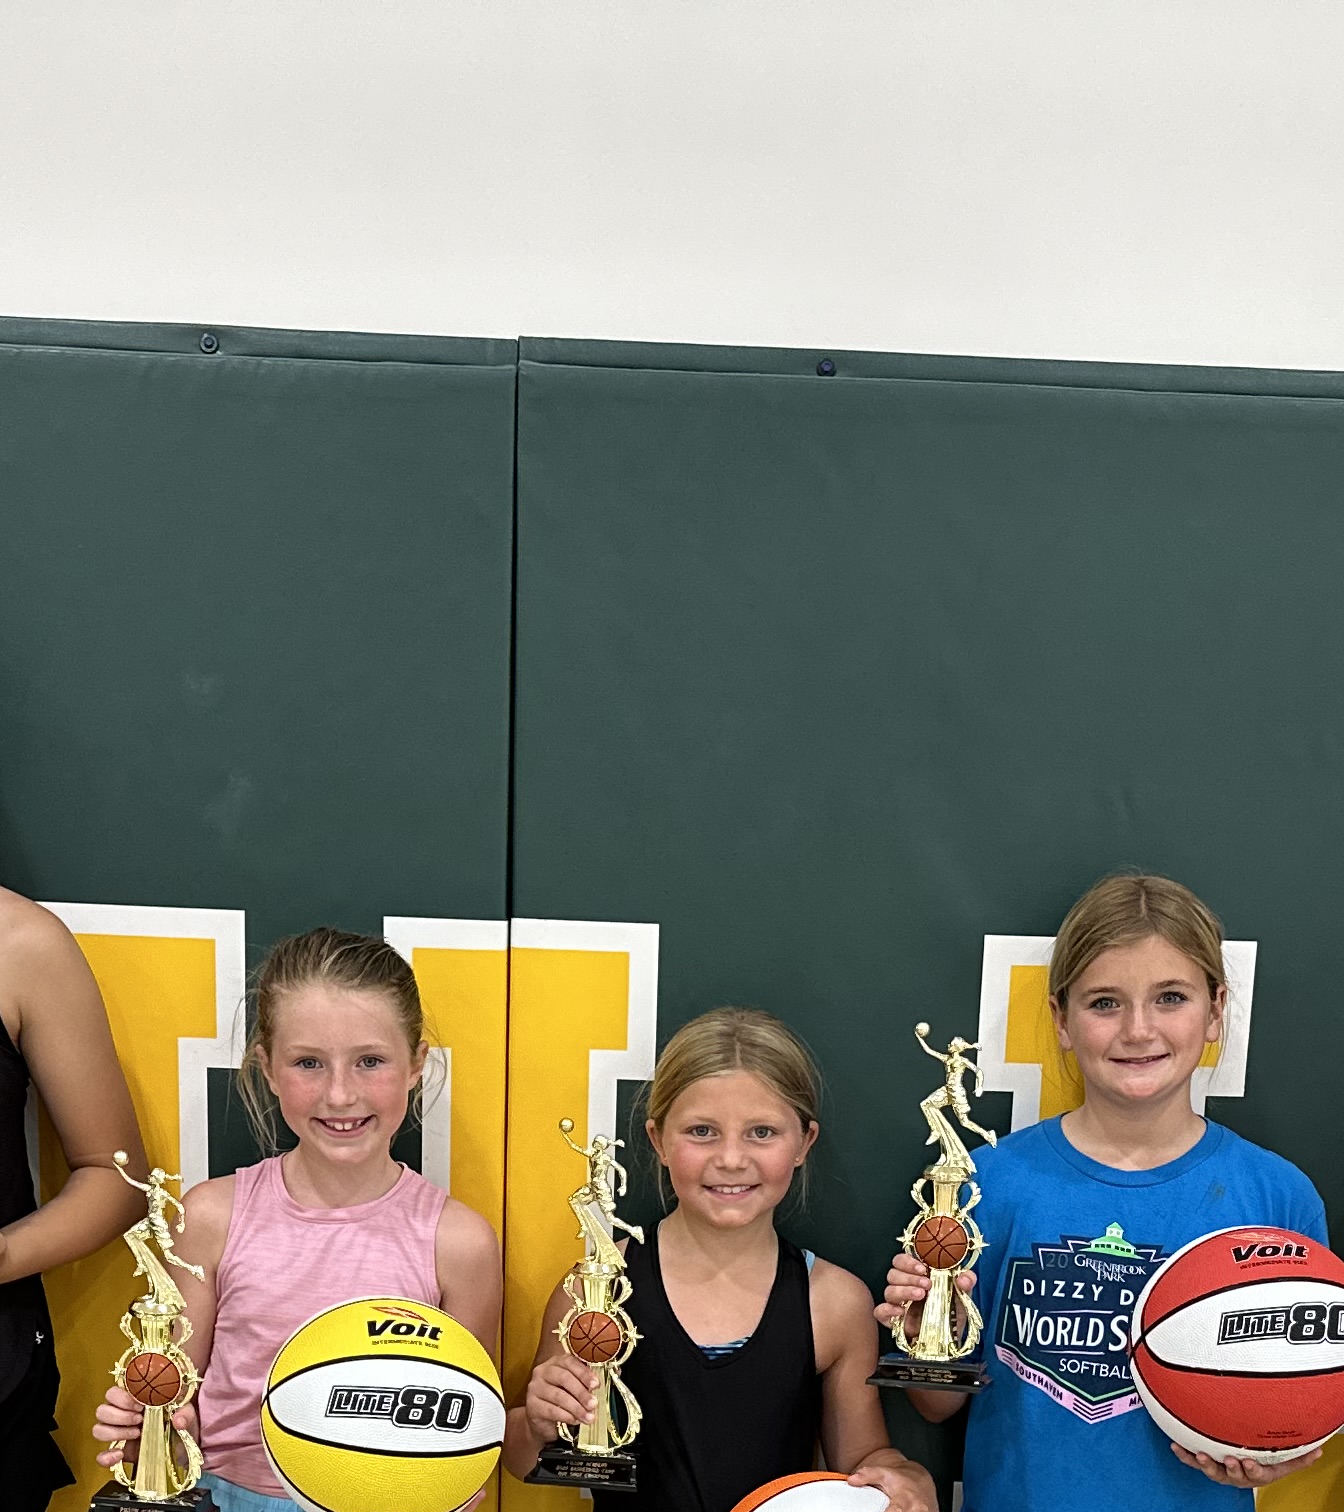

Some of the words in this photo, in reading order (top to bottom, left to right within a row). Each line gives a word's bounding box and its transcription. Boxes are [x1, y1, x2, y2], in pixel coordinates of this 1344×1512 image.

[1232, 1243, 1309, 1263] Voit
[1096, 1268, 1126, 1282] PARK
[1023, 1278, 1104, 1302] DIZZY
[367, 1319, 444, 1341] Voit
[1012, 1303, 1105, 1347] WORLD
[1226, 1312, 1286, 1338] LITE
[1059, 1358, 1133, 1380] SOFTBAL
[1015, 1362, 1063, 1401] SOUTHAVEN
[334, 1391, 395, 1413] LITE
[394, 1388, 473, 1430] 80
